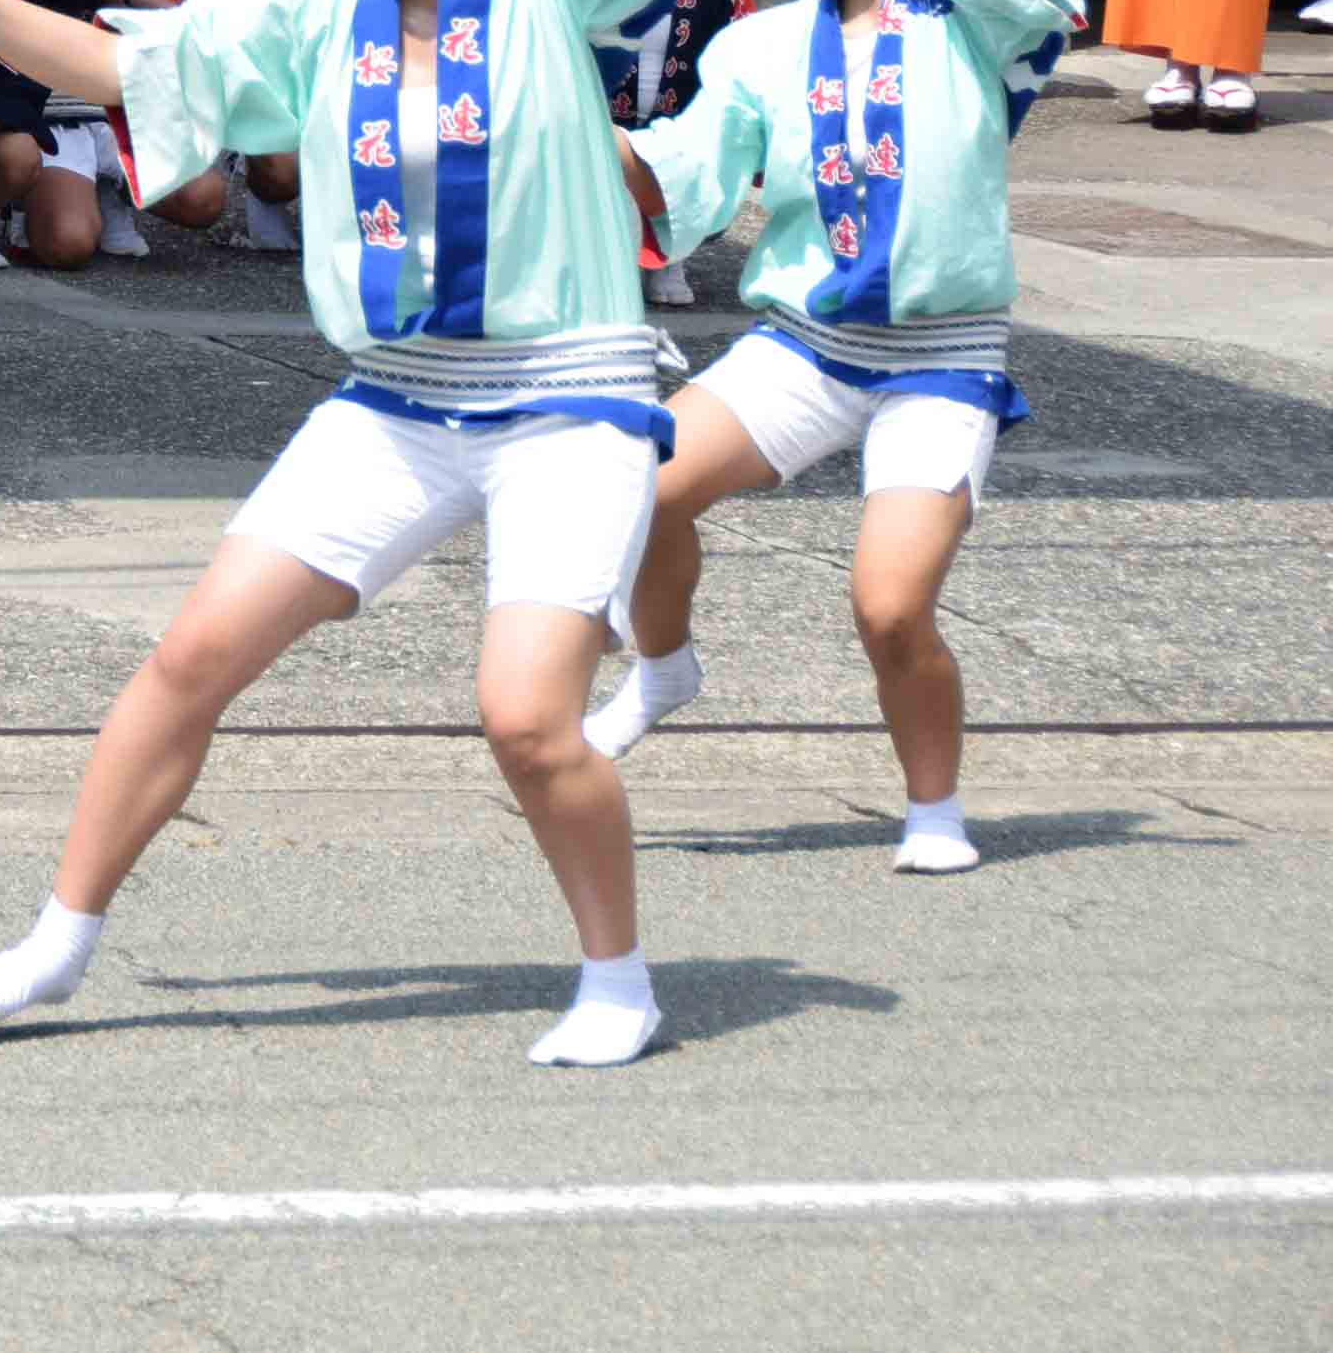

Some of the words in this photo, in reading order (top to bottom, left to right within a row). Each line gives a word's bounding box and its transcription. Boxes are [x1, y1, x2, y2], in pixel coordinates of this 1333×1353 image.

[354, 40, 408, 250] 桜花連
[807, 75, 860, 259] 桜花連
